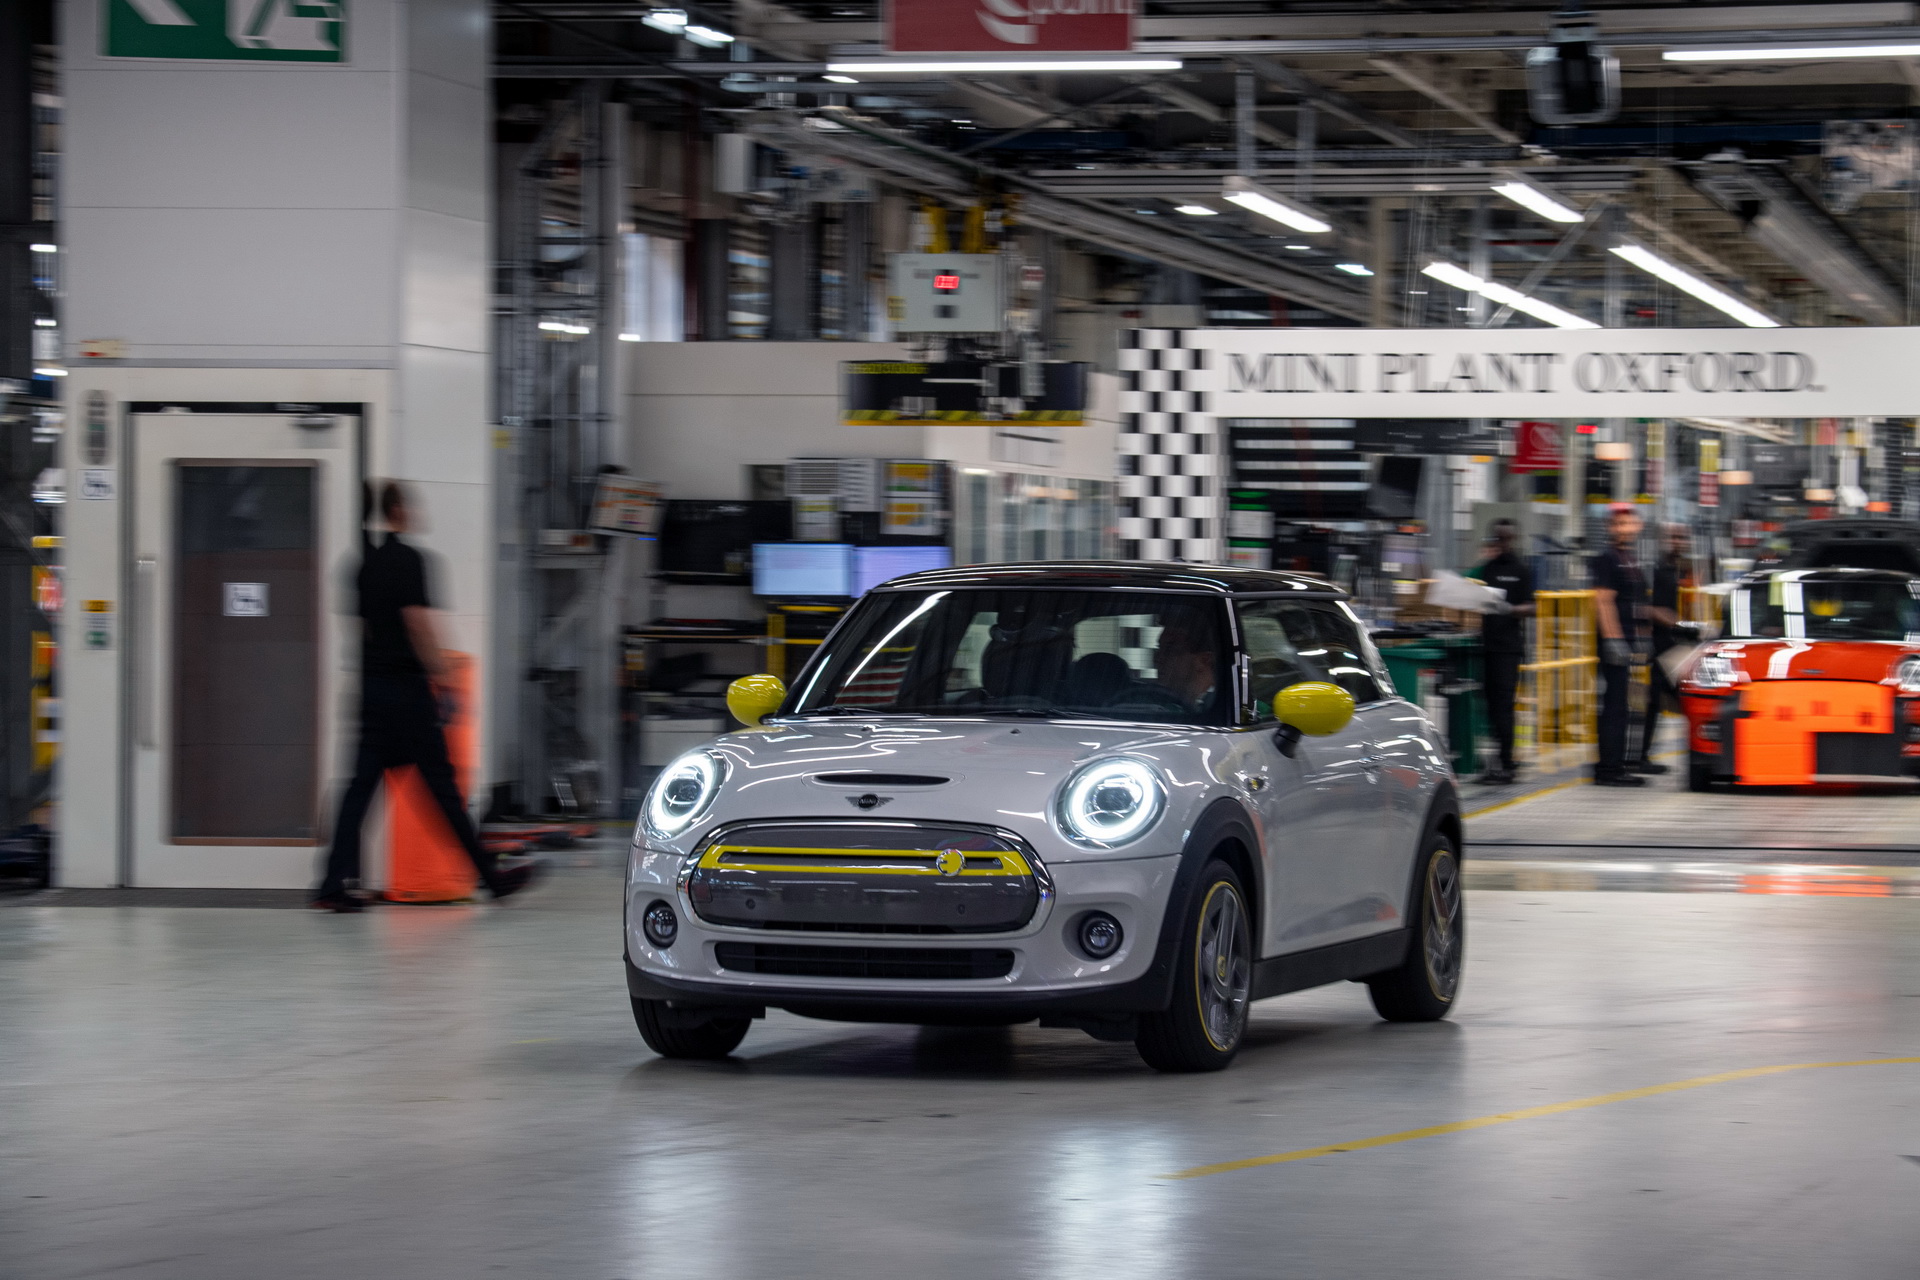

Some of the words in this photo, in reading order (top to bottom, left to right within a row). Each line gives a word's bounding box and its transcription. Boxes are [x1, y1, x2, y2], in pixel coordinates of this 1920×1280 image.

[1225, 352, 1363, 393] MINI
[1373, 352, 1564, 393] PLANT
[1572, 351, 1826, 393] OXFORD.
